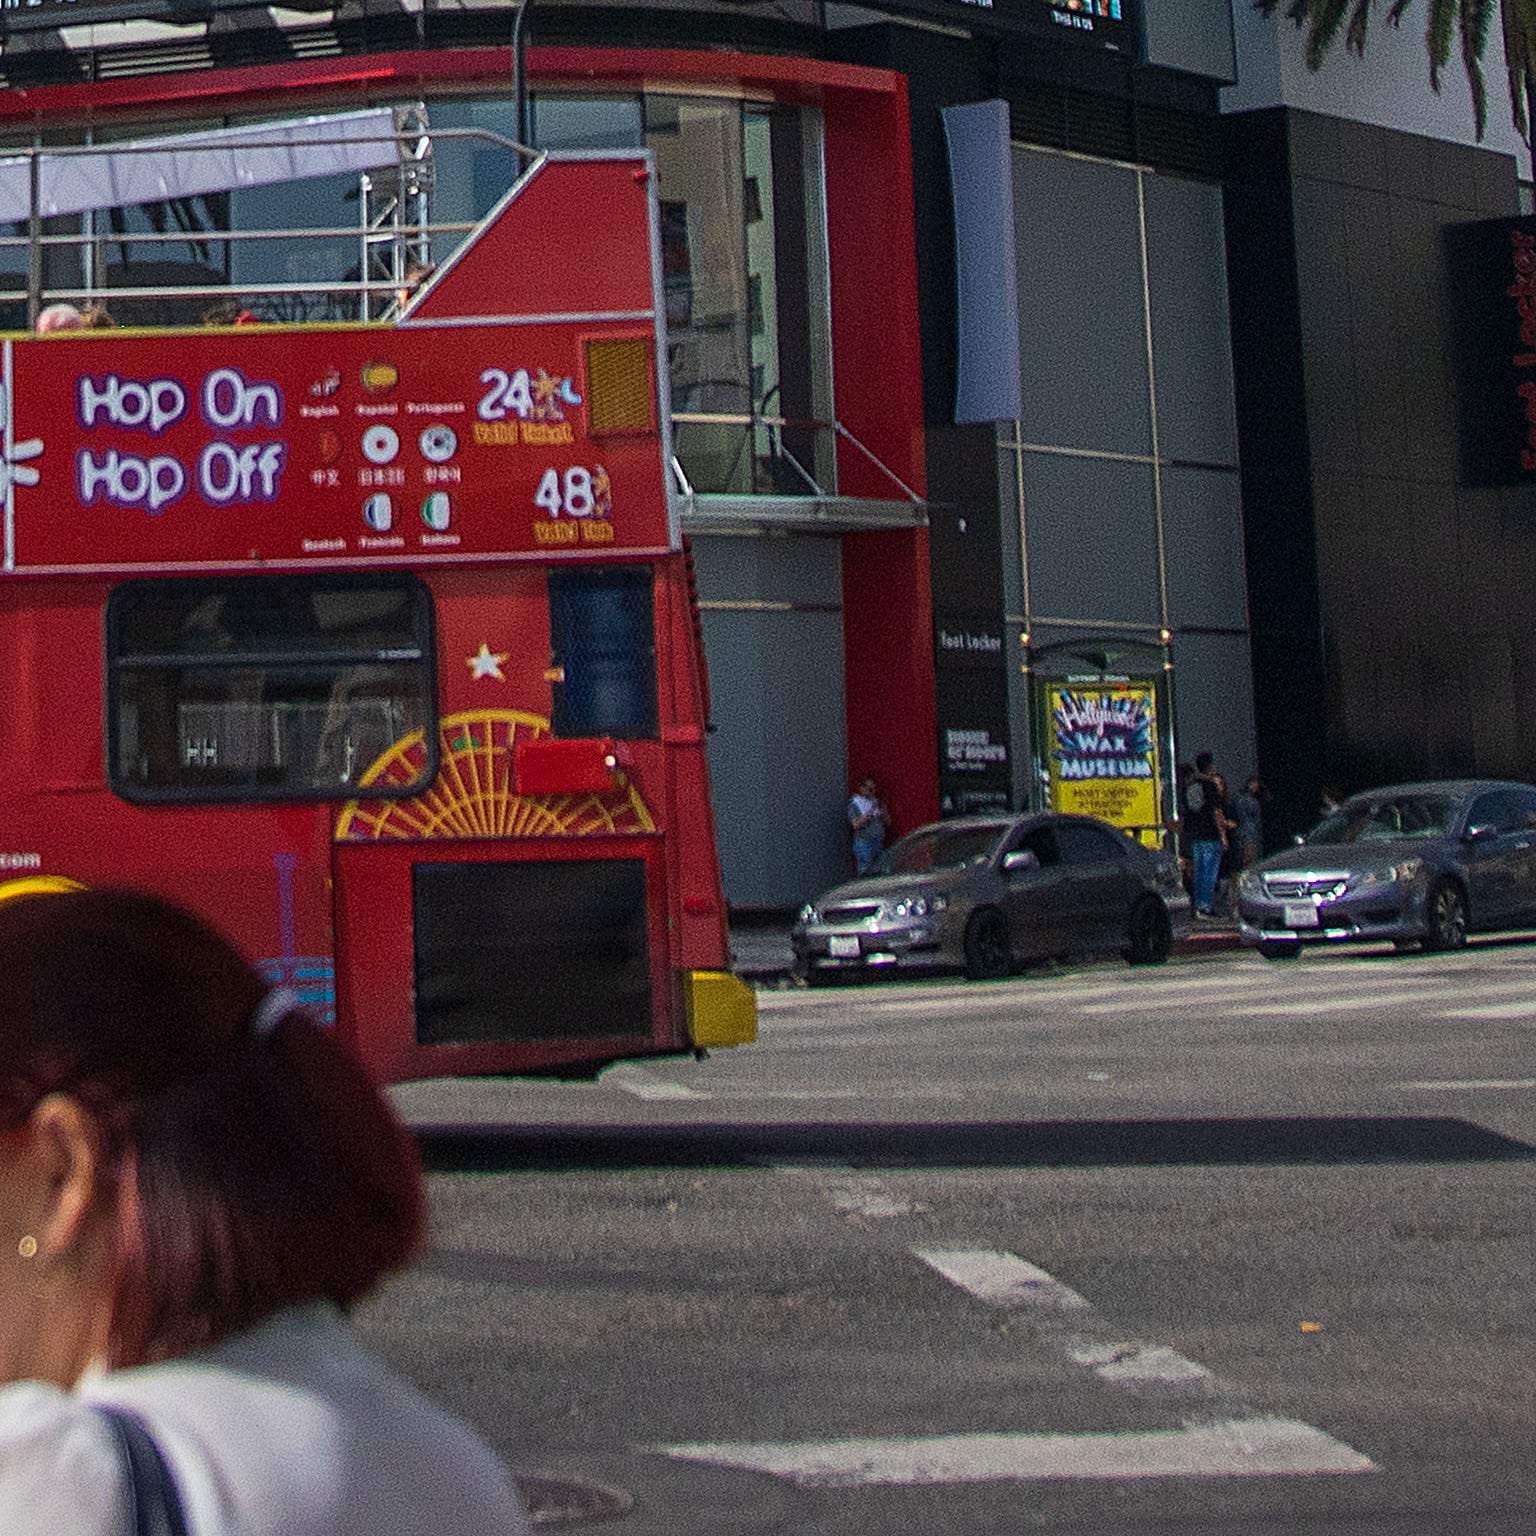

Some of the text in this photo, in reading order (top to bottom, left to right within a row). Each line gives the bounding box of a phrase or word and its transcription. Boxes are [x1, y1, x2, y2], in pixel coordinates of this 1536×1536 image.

[77, 366, 283, 434] Hop On
[76, 440, 287, 514] Hop Off
[1075, 732, 1128, 752] WAX
[1059, 758, 1153, 779] MUSEUM
